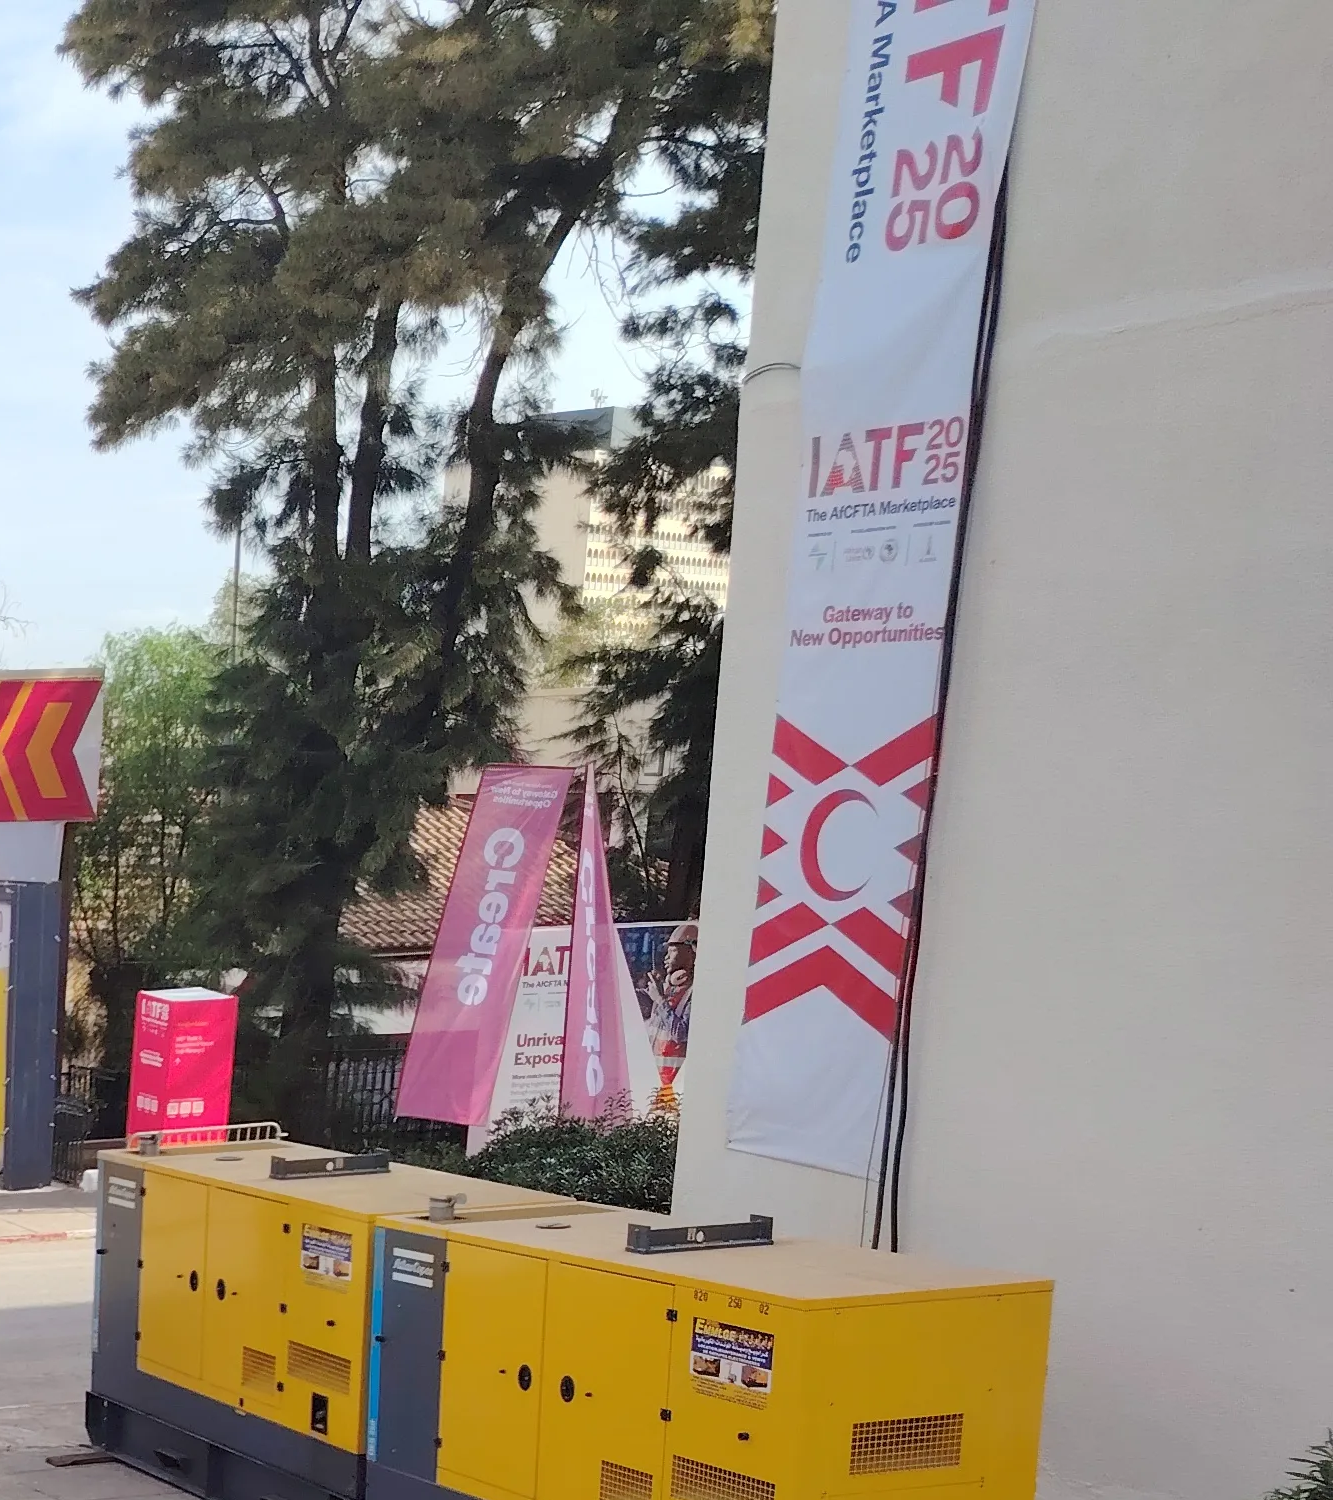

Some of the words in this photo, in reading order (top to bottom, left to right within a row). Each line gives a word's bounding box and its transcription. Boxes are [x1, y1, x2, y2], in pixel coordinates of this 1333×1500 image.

[845, 32, 895, 264] Marketplace
[885, 140, 938, 252] 25
[938, 126, 983, 240] 20
[925, 416, 965, 451] 20
[807, 421, 925, 498] IATF
[921, 451, 961, 486] 25
[806, 508, 827, 522] The
[829, 502, 877, 520] AfCFTA
[878, 495, 957, 516] Marketplace
[822, 604, 893, 625] Gateway
[896, 601, 914, 619] to
[789, 628, 825, 648] New
[828, 622, 946, 649] Opportunities
[523, 946, 572, 977] IAT
[516, 1033, 565, 1047] Unriva
